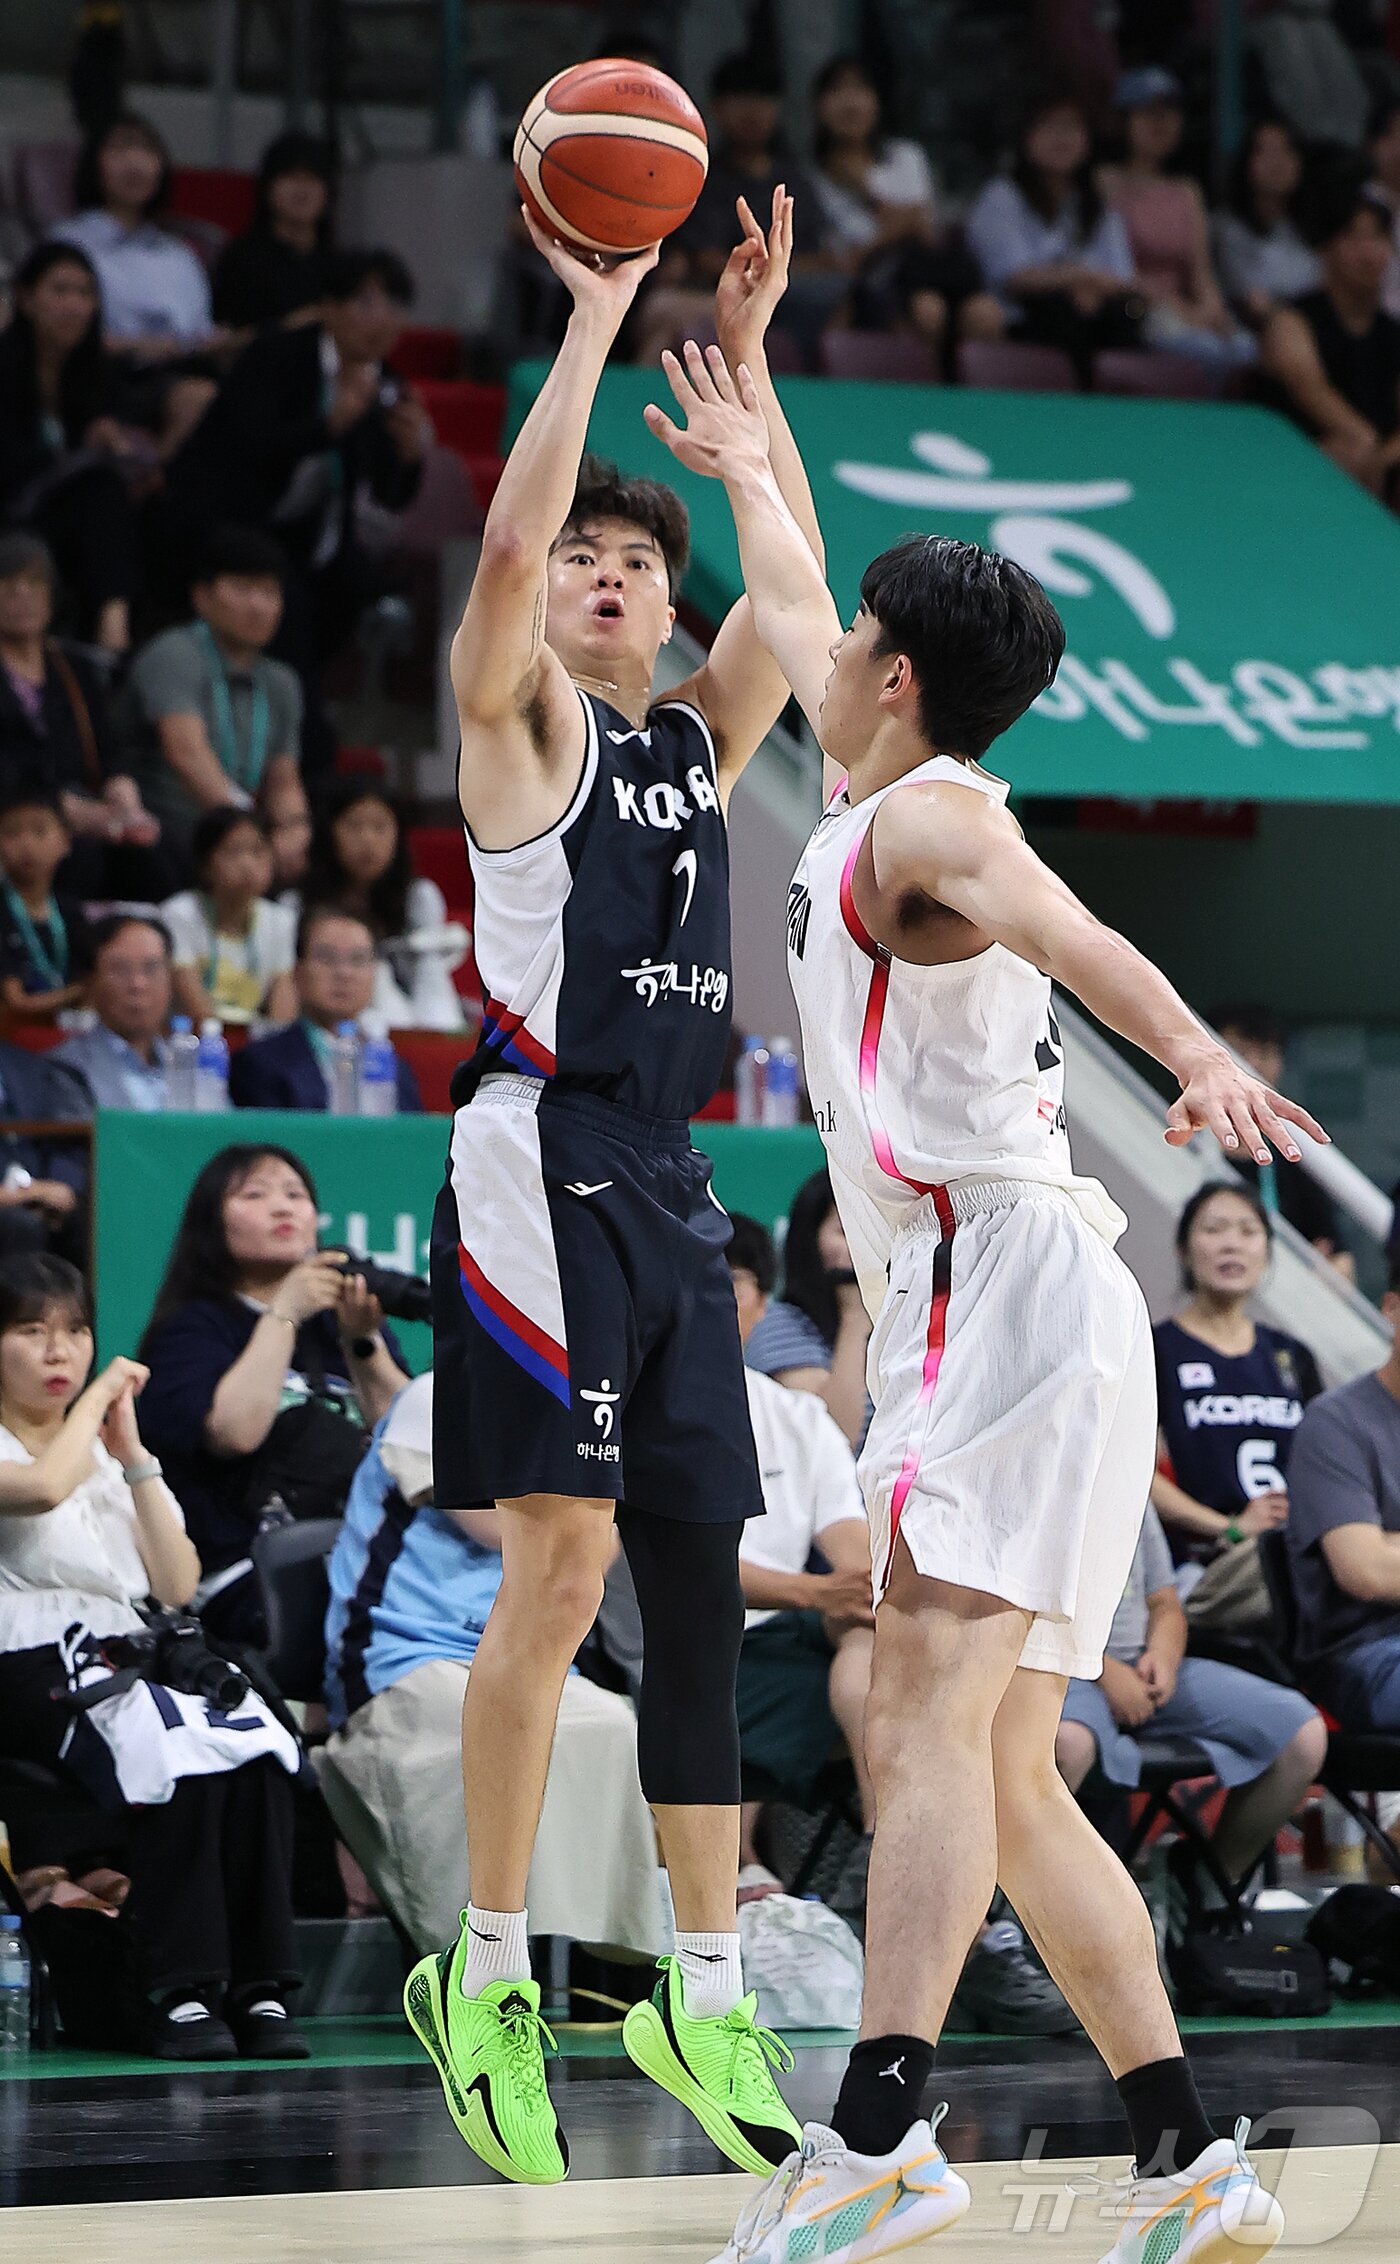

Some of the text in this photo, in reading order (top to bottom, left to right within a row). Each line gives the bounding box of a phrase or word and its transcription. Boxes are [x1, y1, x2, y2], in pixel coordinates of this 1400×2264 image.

[612, 765, 720, 831] KORA
[672, 849, 698, 927] 7
[576, 1442, 620, 1463] 하나은행
[1236, 1438, 1289, 1501] 6
